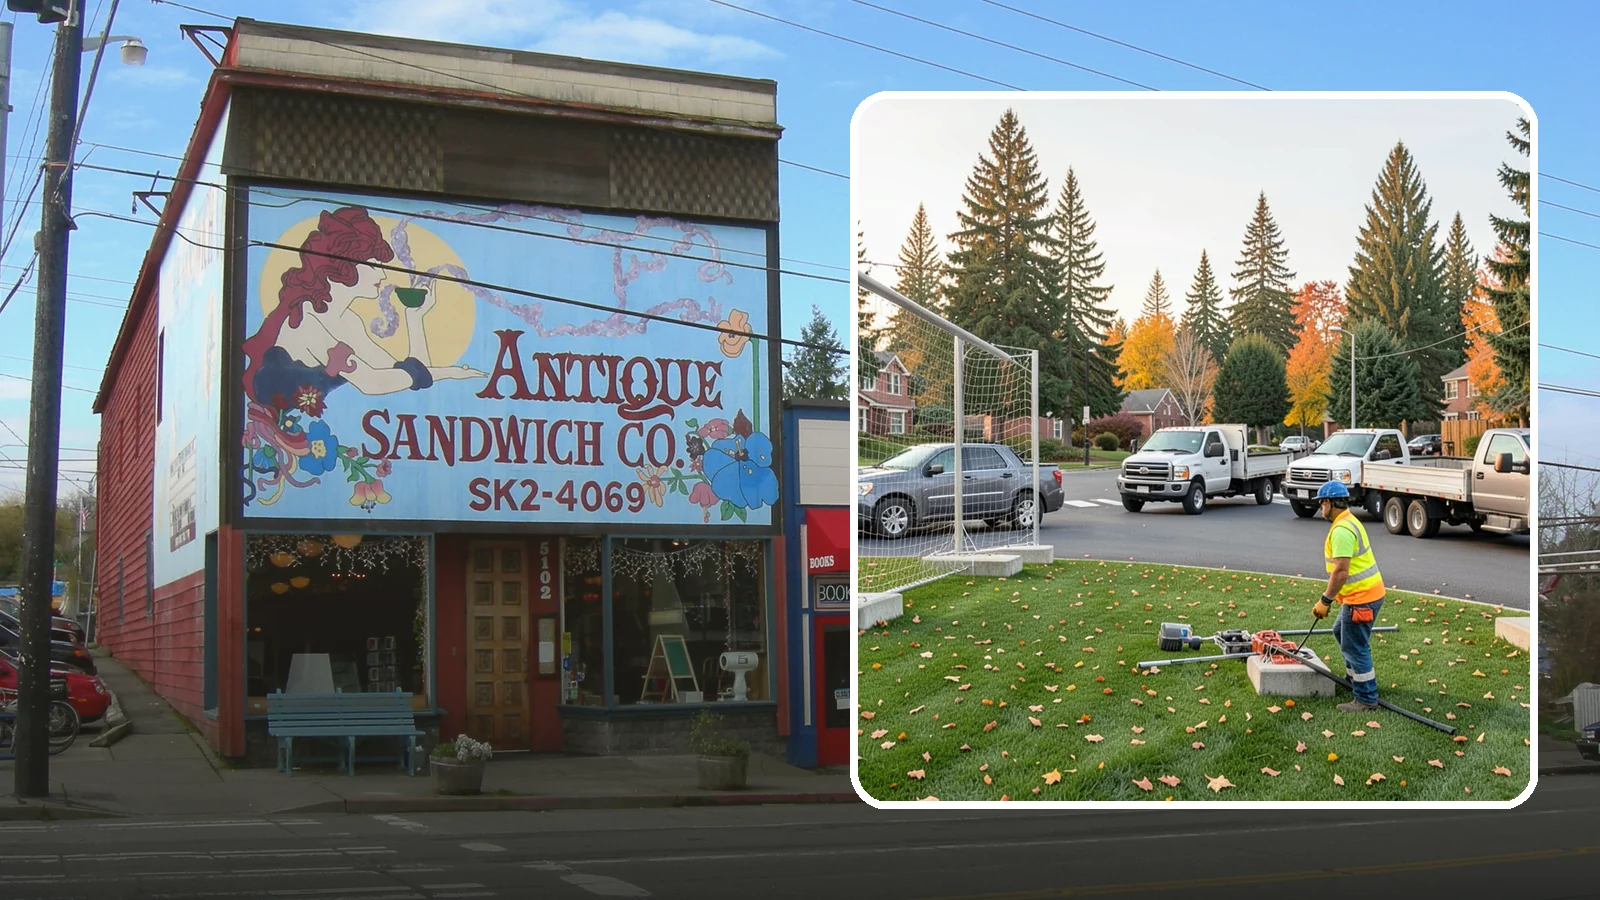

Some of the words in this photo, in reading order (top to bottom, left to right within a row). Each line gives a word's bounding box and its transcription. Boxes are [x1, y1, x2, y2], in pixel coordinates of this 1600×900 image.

[476, 329, 723, 421] ANTIQUE
[361, 408, 604, 467] SANDWICH
[617, 422, 685, 469] CO.
[469, 477, 645, 513] SK2-4069
[540, 542, 552, 599] 5102
[809, 555, 835, 569] BOOKS
